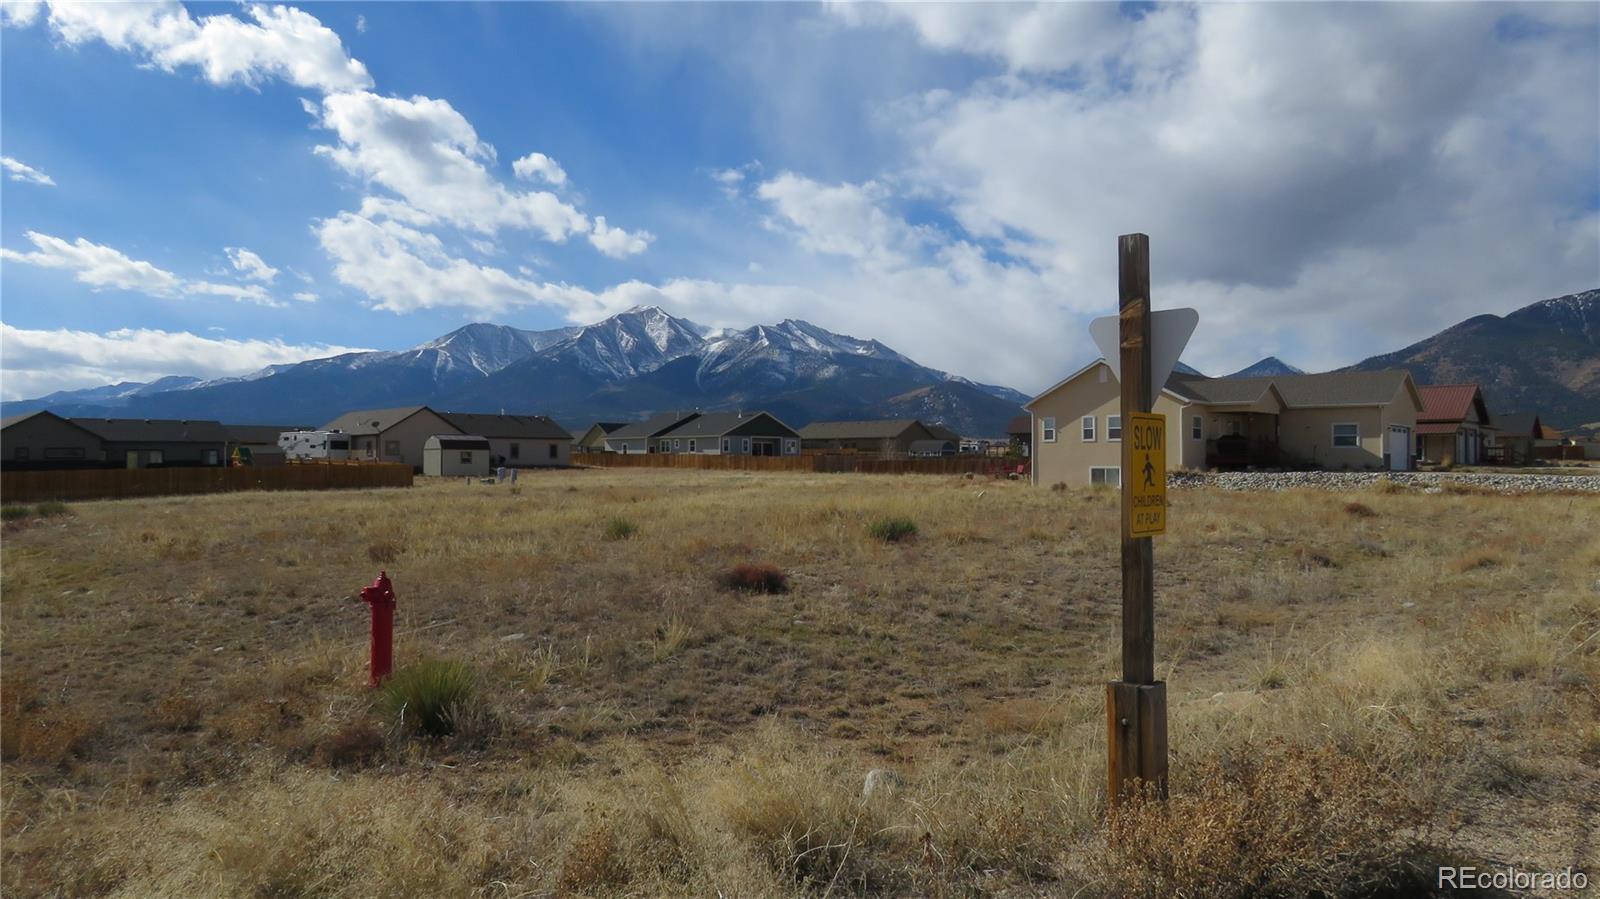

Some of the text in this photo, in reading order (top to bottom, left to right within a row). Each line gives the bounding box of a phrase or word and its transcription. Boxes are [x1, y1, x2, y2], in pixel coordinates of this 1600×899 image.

[1134, 425, 1161, 450] SLOW
[1134, 495, 1163, 507] CHILDREN
[1136, 511, 1160, 526] AT PLAY
